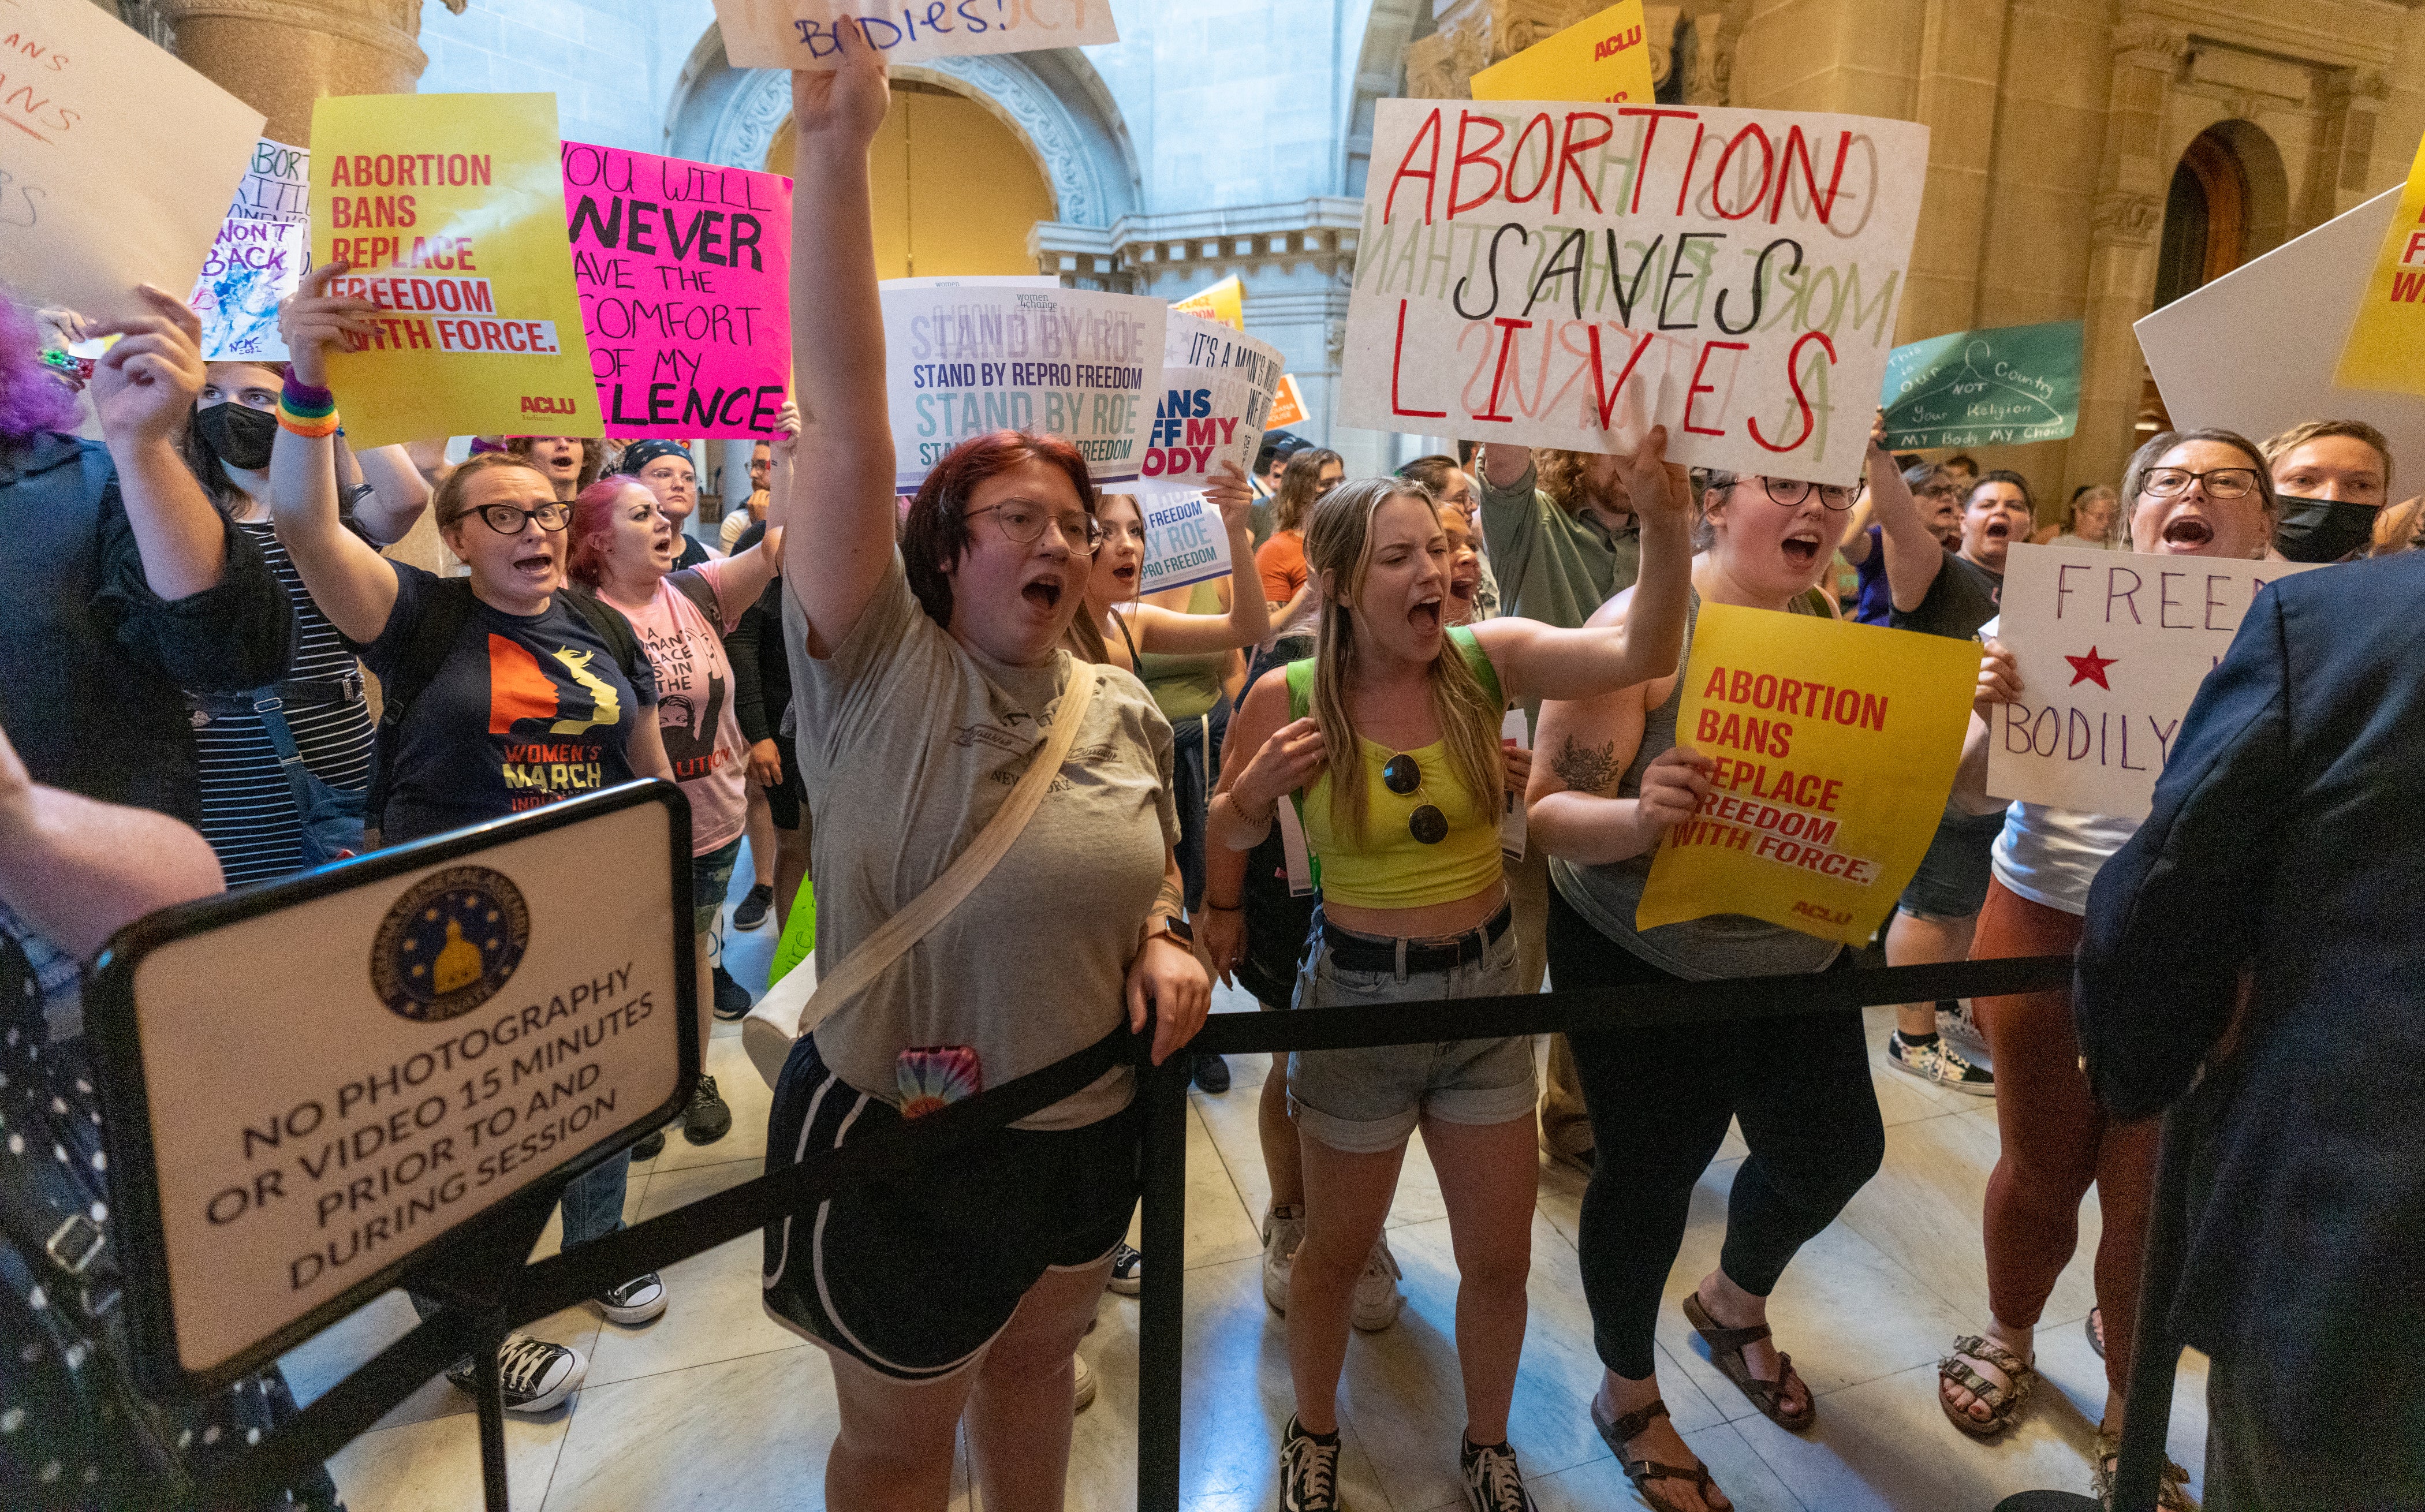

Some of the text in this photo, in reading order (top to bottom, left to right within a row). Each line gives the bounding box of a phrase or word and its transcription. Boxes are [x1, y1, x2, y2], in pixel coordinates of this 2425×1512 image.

[1594, 24, 1641, 62] ACLU
[331, 154, 491, 188] ABORTION
[1383, 107, 1851, 226] ABORTION
[663, 160, 771, 211] WILL
[333, 195, 416, 228] BANS
[568, 195, 763, 272] NEVER
[333, 237, 476, 271] REPLACE
[575, 251, 715, 293] AVE THE
[1453, 222, 1803, 335] SAVES
[332, 278, 492, 312] FREEDOM
[1020, 300, 1057, 310] 4change
[437, 320, 557, 353] FORCE.
[911, 314, 1145, 364] STAND BY ROE
[1189, 332, 1218, 367] IT'S
[1221, 342, 1231, 367] A
[590, 348, 702, 386] OF MY
[1889, 346, 1922, 367] This
[913, 363, 1143, 390] STAND BY REPRO FREEDOM
[1391, 298, 1838, 453] LIVES
[1953, 382, 1987, 395] NOT
[1995, 362, 2055, 399] Country
[521, 396, 576, 415] ACLU
[594, 382, 784, 432] LENCE
[916, 391, 1140, 437] STAND BY ROE
[1156, 389, 1211, 419] ANS
[1912, 404, 2031, 427] Your Religion
[1148, 417, 1239, 447] FF MY
[1942, 433, 1979, 447] Body
[920, 439, 1133, 465] STA FREEDOM
[1141, 446, 1215, 476] ODY
[1148, 501, 1202, 528] FREEDOM
[1167, 517, 1212, 552] ROE
[1141, 546, 1217, 580] PRO FREEDOM
[648, 627, 658, 640] A
[648, 645, 693, 665] LACE
[653, 662, 693, 679] S IN
[655, 675, 692, 693] THE
[1704, 666, 1888, 731] ABORTION
[1696, 708, 1793, 758] BANS
[2006, 703, 2177, 771] BODILY
[505, 744, 602, 763] WOMEN'S
[676, 746, 730, 776] UTION
[502, 763, 601, 794] MARCH
[1047, 779, 1074, 794] ORK
[1711, 756, 1842, 812] EPLACE
[1695, 793, 1837, 844] REEDOM
[1672, 820, 1870, 883] WITH FORCE.
[1792, 901, 1853, 925] ACLU
[241, 962, 632, 1159] NO PHOTOGRAPHY
[206, 992, 653, 1227] OR VIDEO 15 MINUTES
[317, 1062, 600, 1228] PRIOR TO AND
[290, 1088, 617, 1291] DURING SESSION
